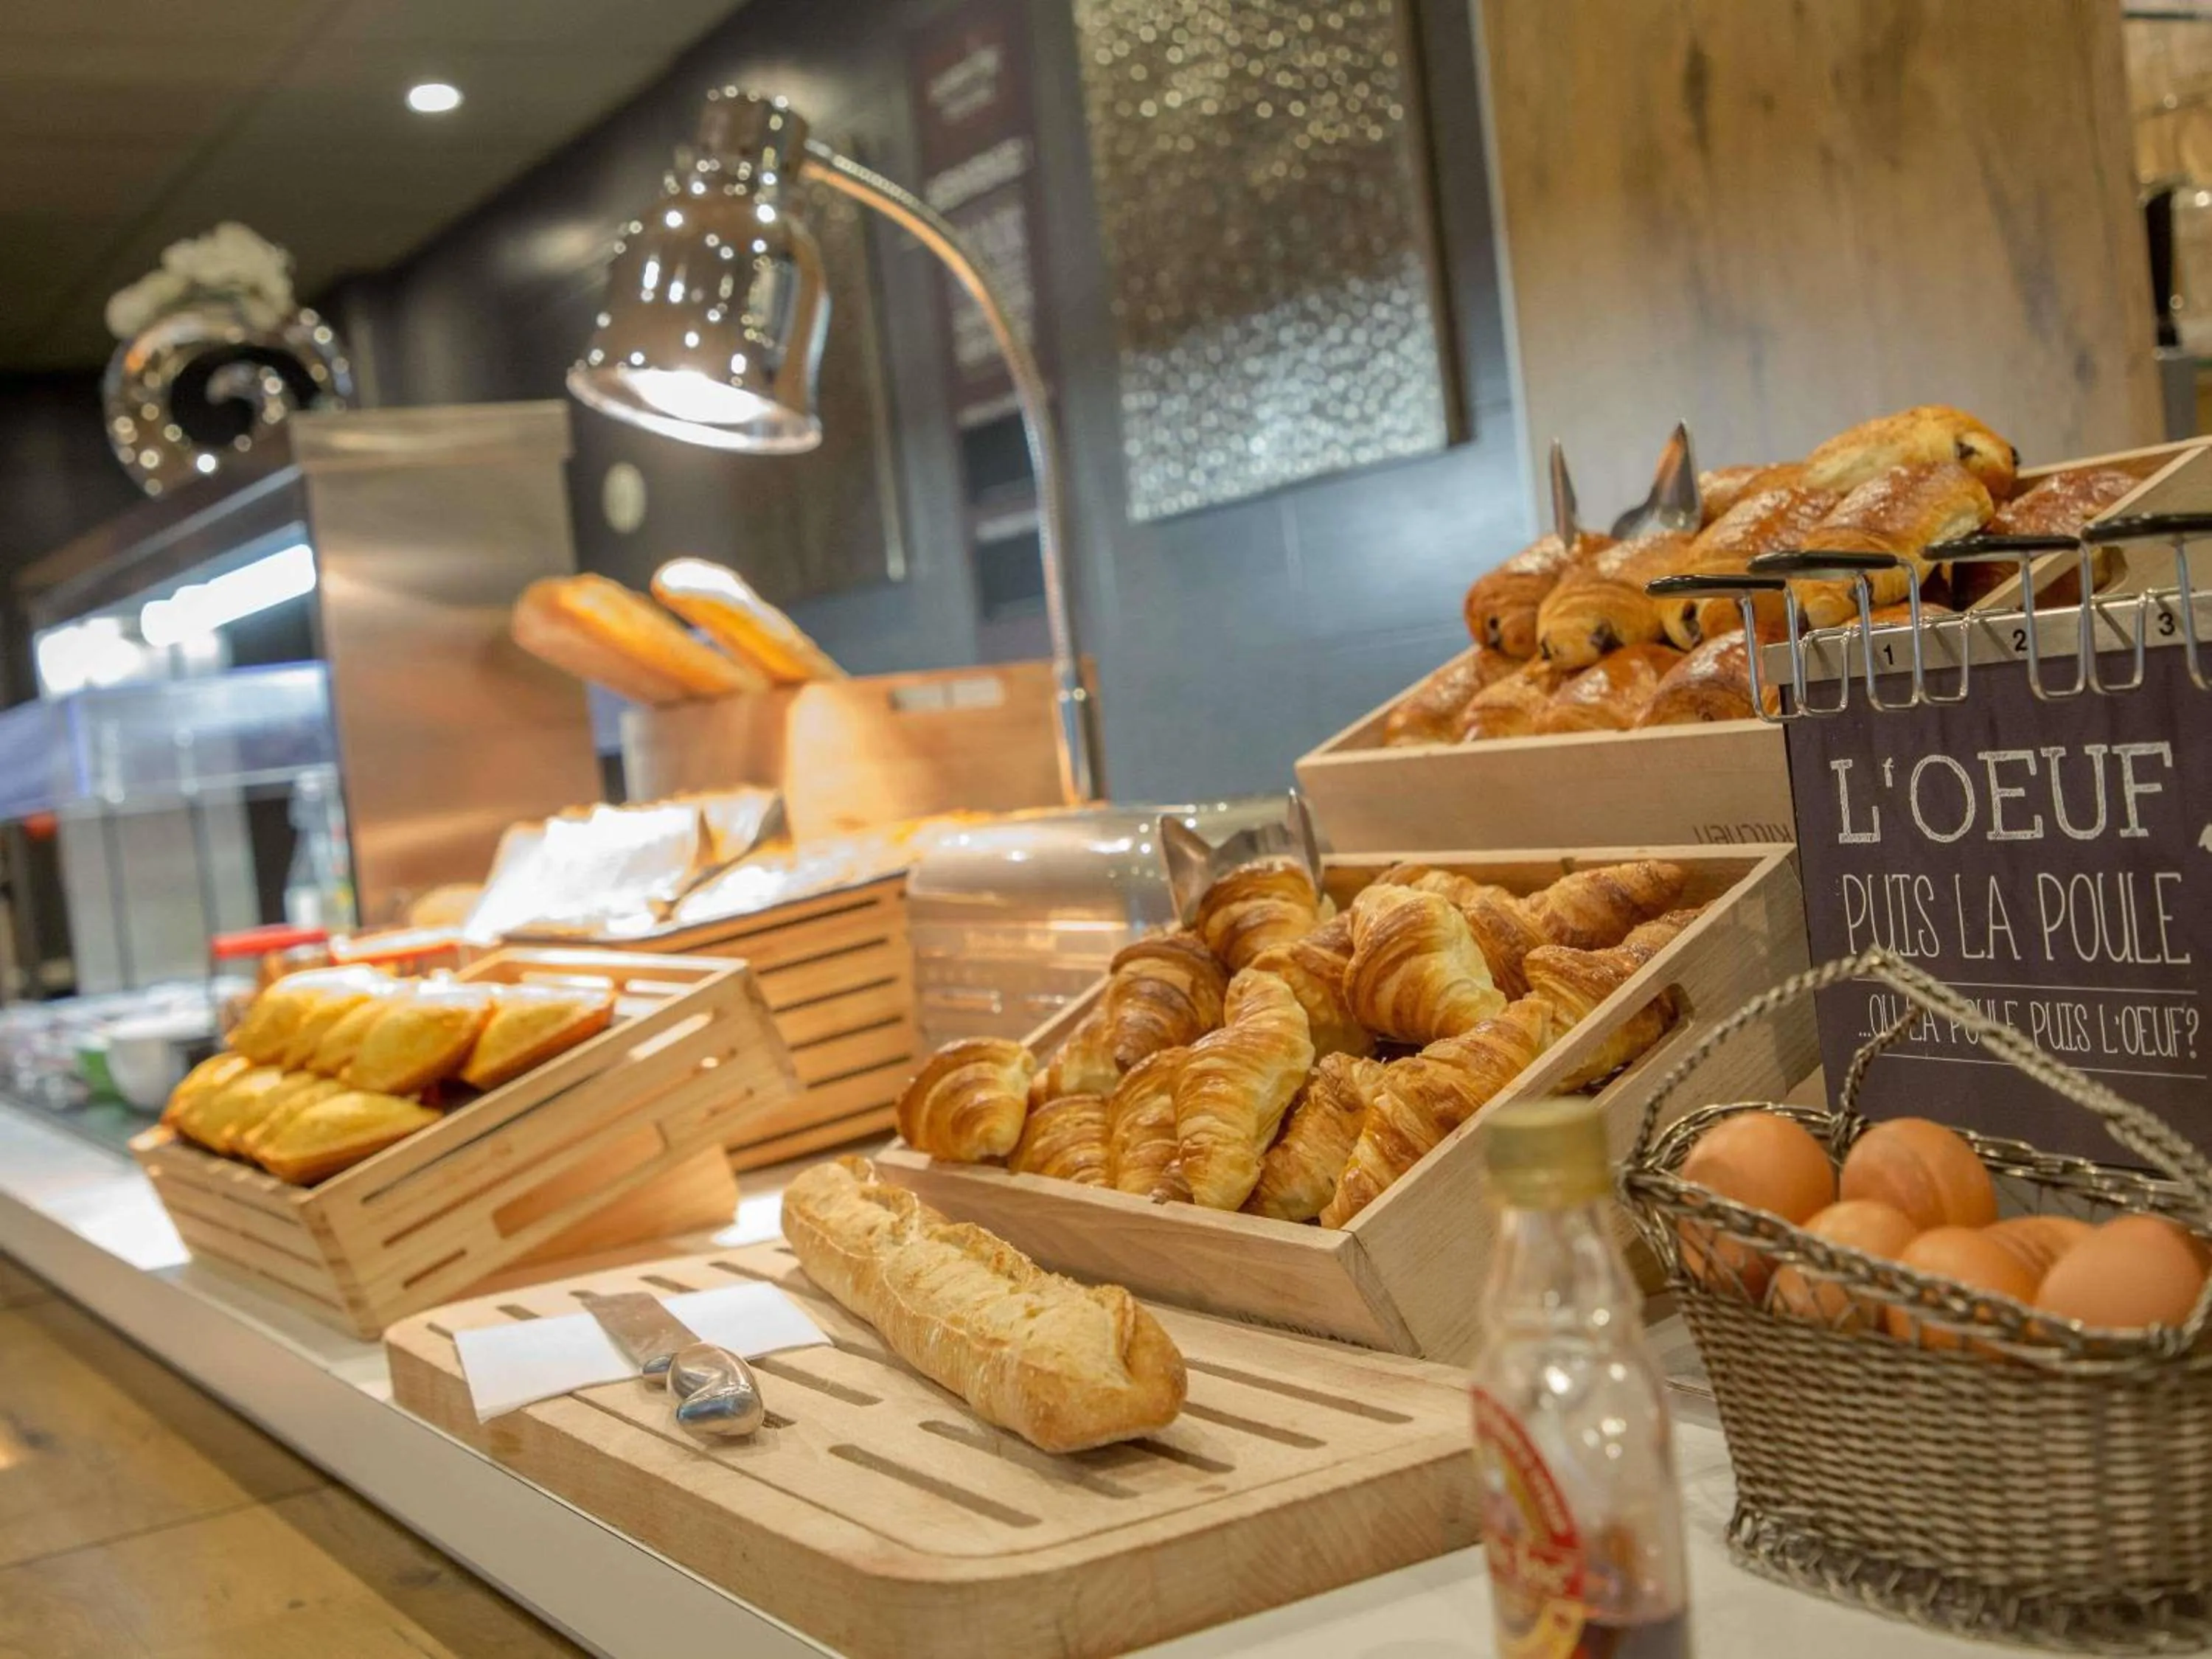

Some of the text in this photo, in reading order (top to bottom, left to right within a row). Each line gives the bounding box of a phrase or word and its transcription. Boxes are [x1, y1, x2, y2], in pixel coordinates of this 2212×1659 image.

[1883, 612, 2176, 665] 1 2 3
[1830, 741, 2173, 844] L'OEUF
[1843, 872, 2191, 964] PUIS LA POULE
[2030, 1001, 2091, 1052] PUIS
[2099, 1004, 2199, 1059] L'OEUF?
